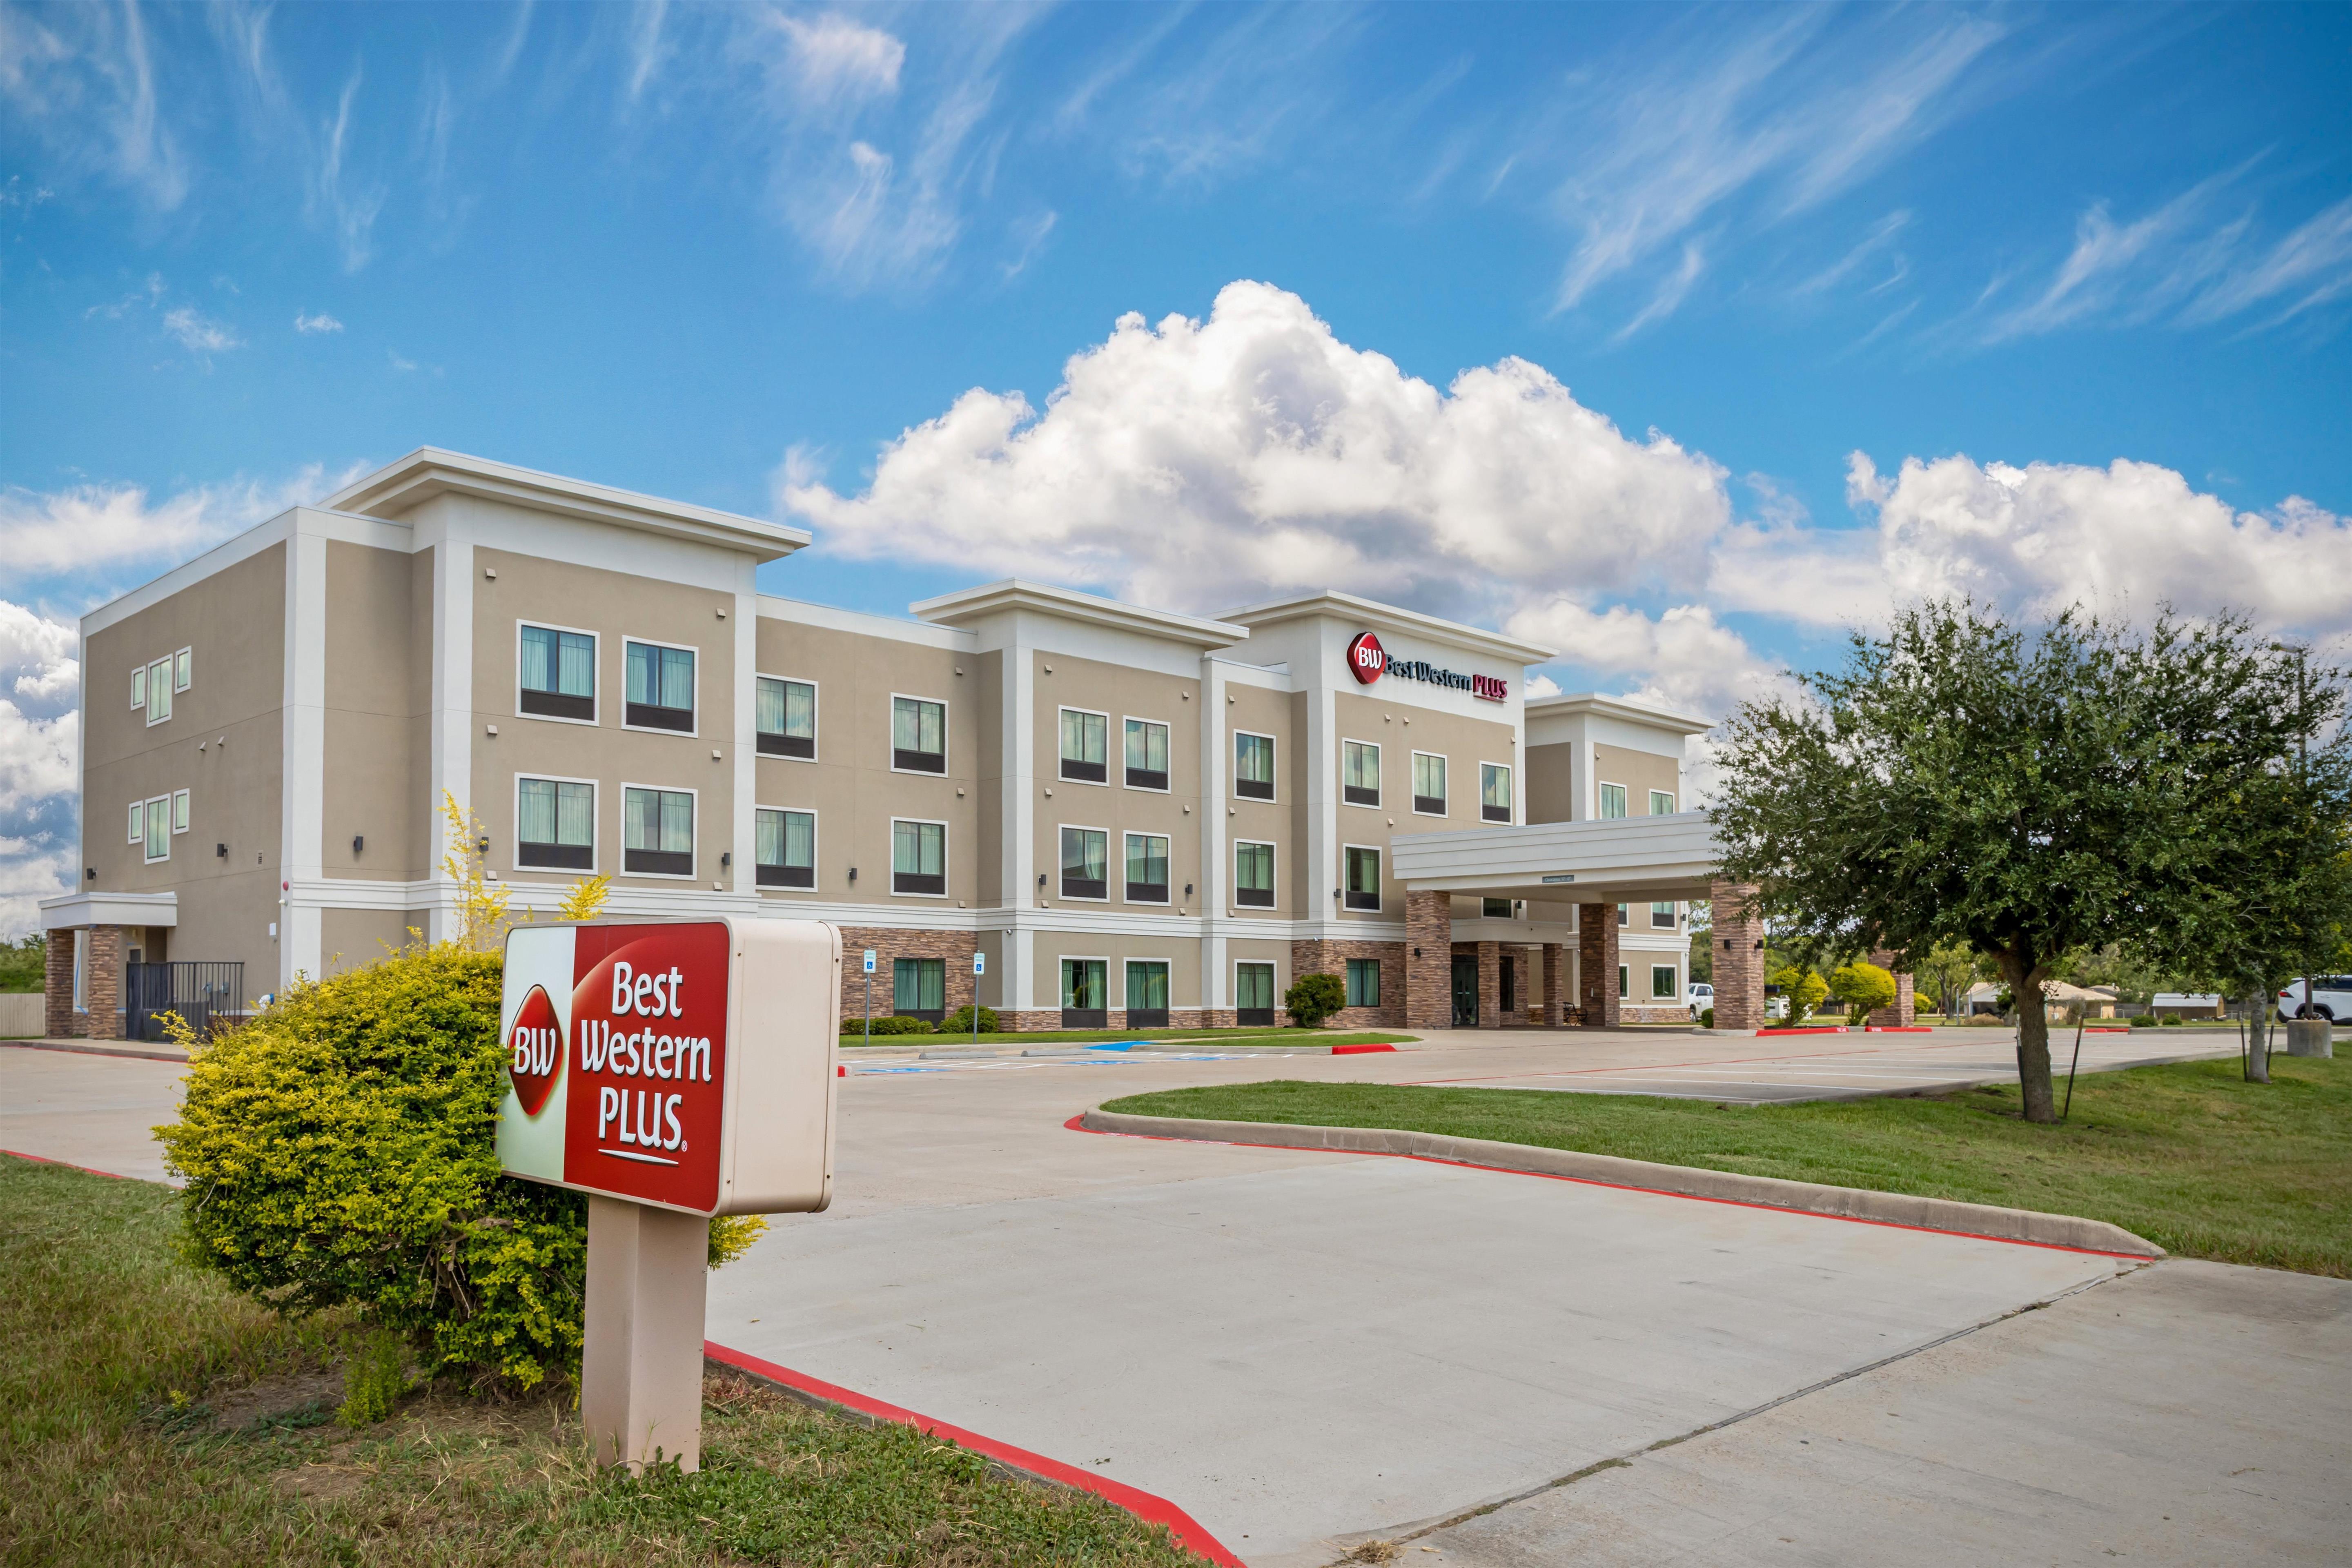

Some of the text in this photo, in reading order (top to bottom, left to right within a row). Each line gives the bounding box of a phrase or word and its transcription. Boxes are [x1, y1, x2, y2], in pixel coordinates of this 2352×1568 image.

[1358, 647, 1382, 669] BW
[1384, 654, 1508, 698] Best Western PLUS
[612, 961, 683, 1017] Best
[514, 1027, 556, 1076] BW
[581, 1020, 712, 1082] Western
